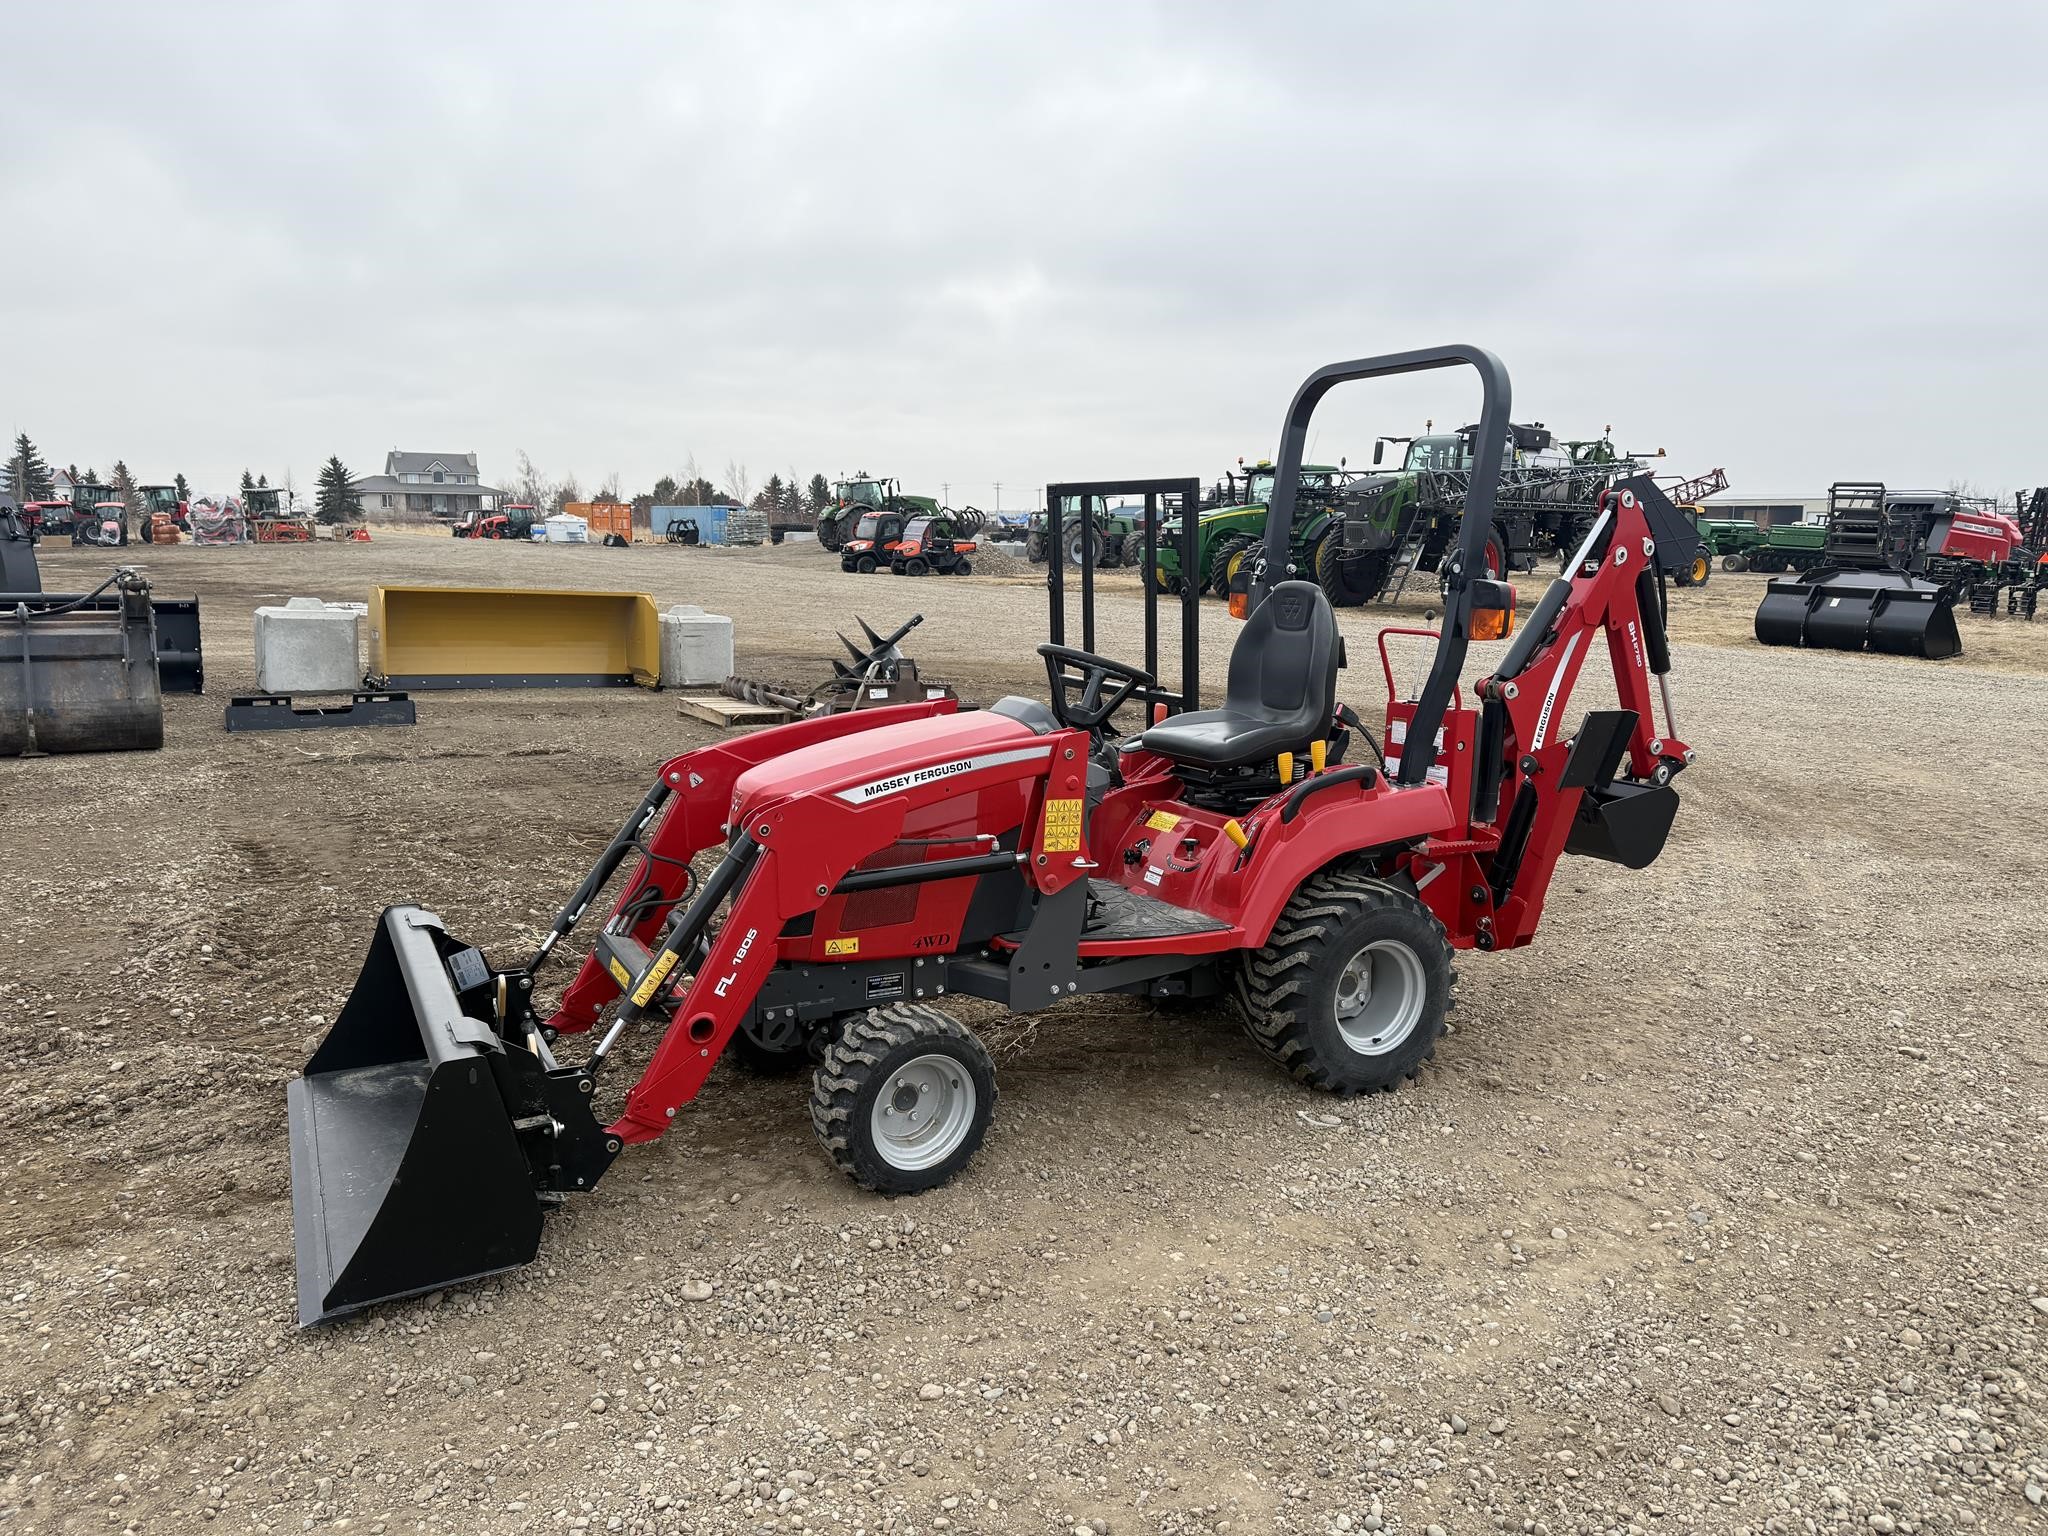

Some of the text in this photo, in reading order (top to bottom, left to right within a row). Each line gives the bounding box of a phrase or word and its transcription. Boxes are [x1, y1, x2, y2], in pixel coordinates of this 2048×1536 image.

[1535, 692, 1555, 744] FERGUSON
[864, 760, 973, 797] MASSEY FERGUSON
[714, 928, 758, 998] FL 1805
[912, 934, 951, 949] 4WD
